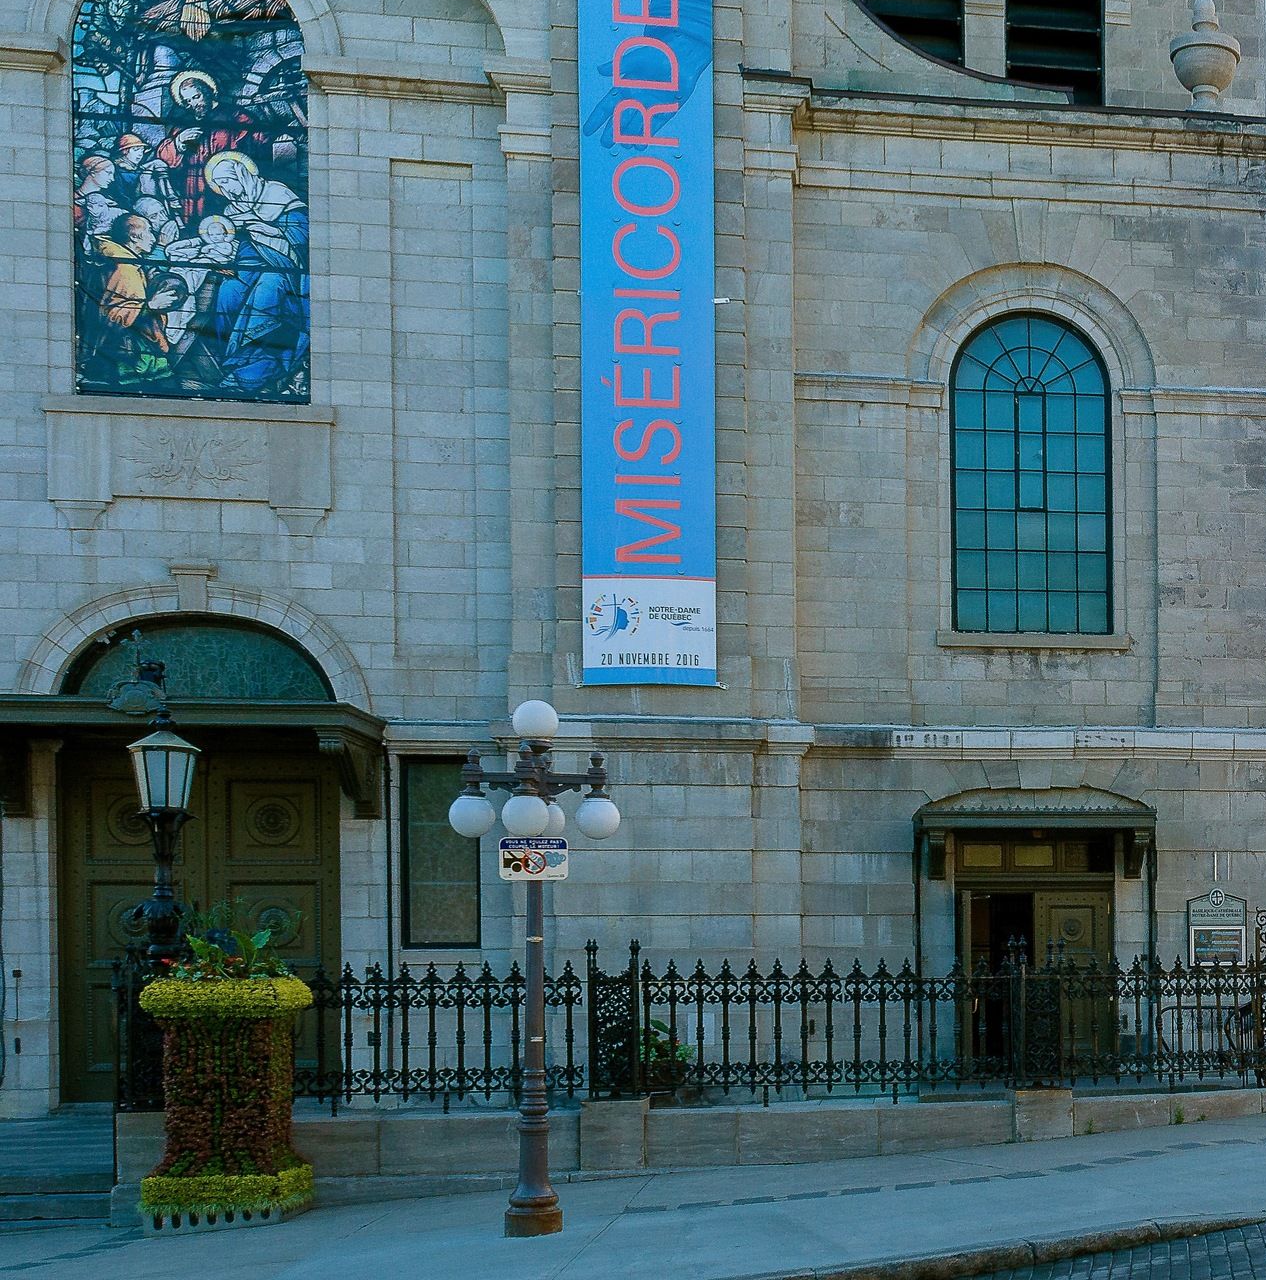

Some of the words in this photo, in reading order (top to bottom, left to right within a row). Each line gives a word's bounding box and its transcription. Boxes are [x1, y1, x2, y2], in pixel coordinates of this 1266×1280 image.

[660, 612, 692, 621] QUÉBEC
[601, 653, 612, 665] 20
[618, 653, 670, 665] NOVEMBRE
[676, 653, 700, 666] 2016
